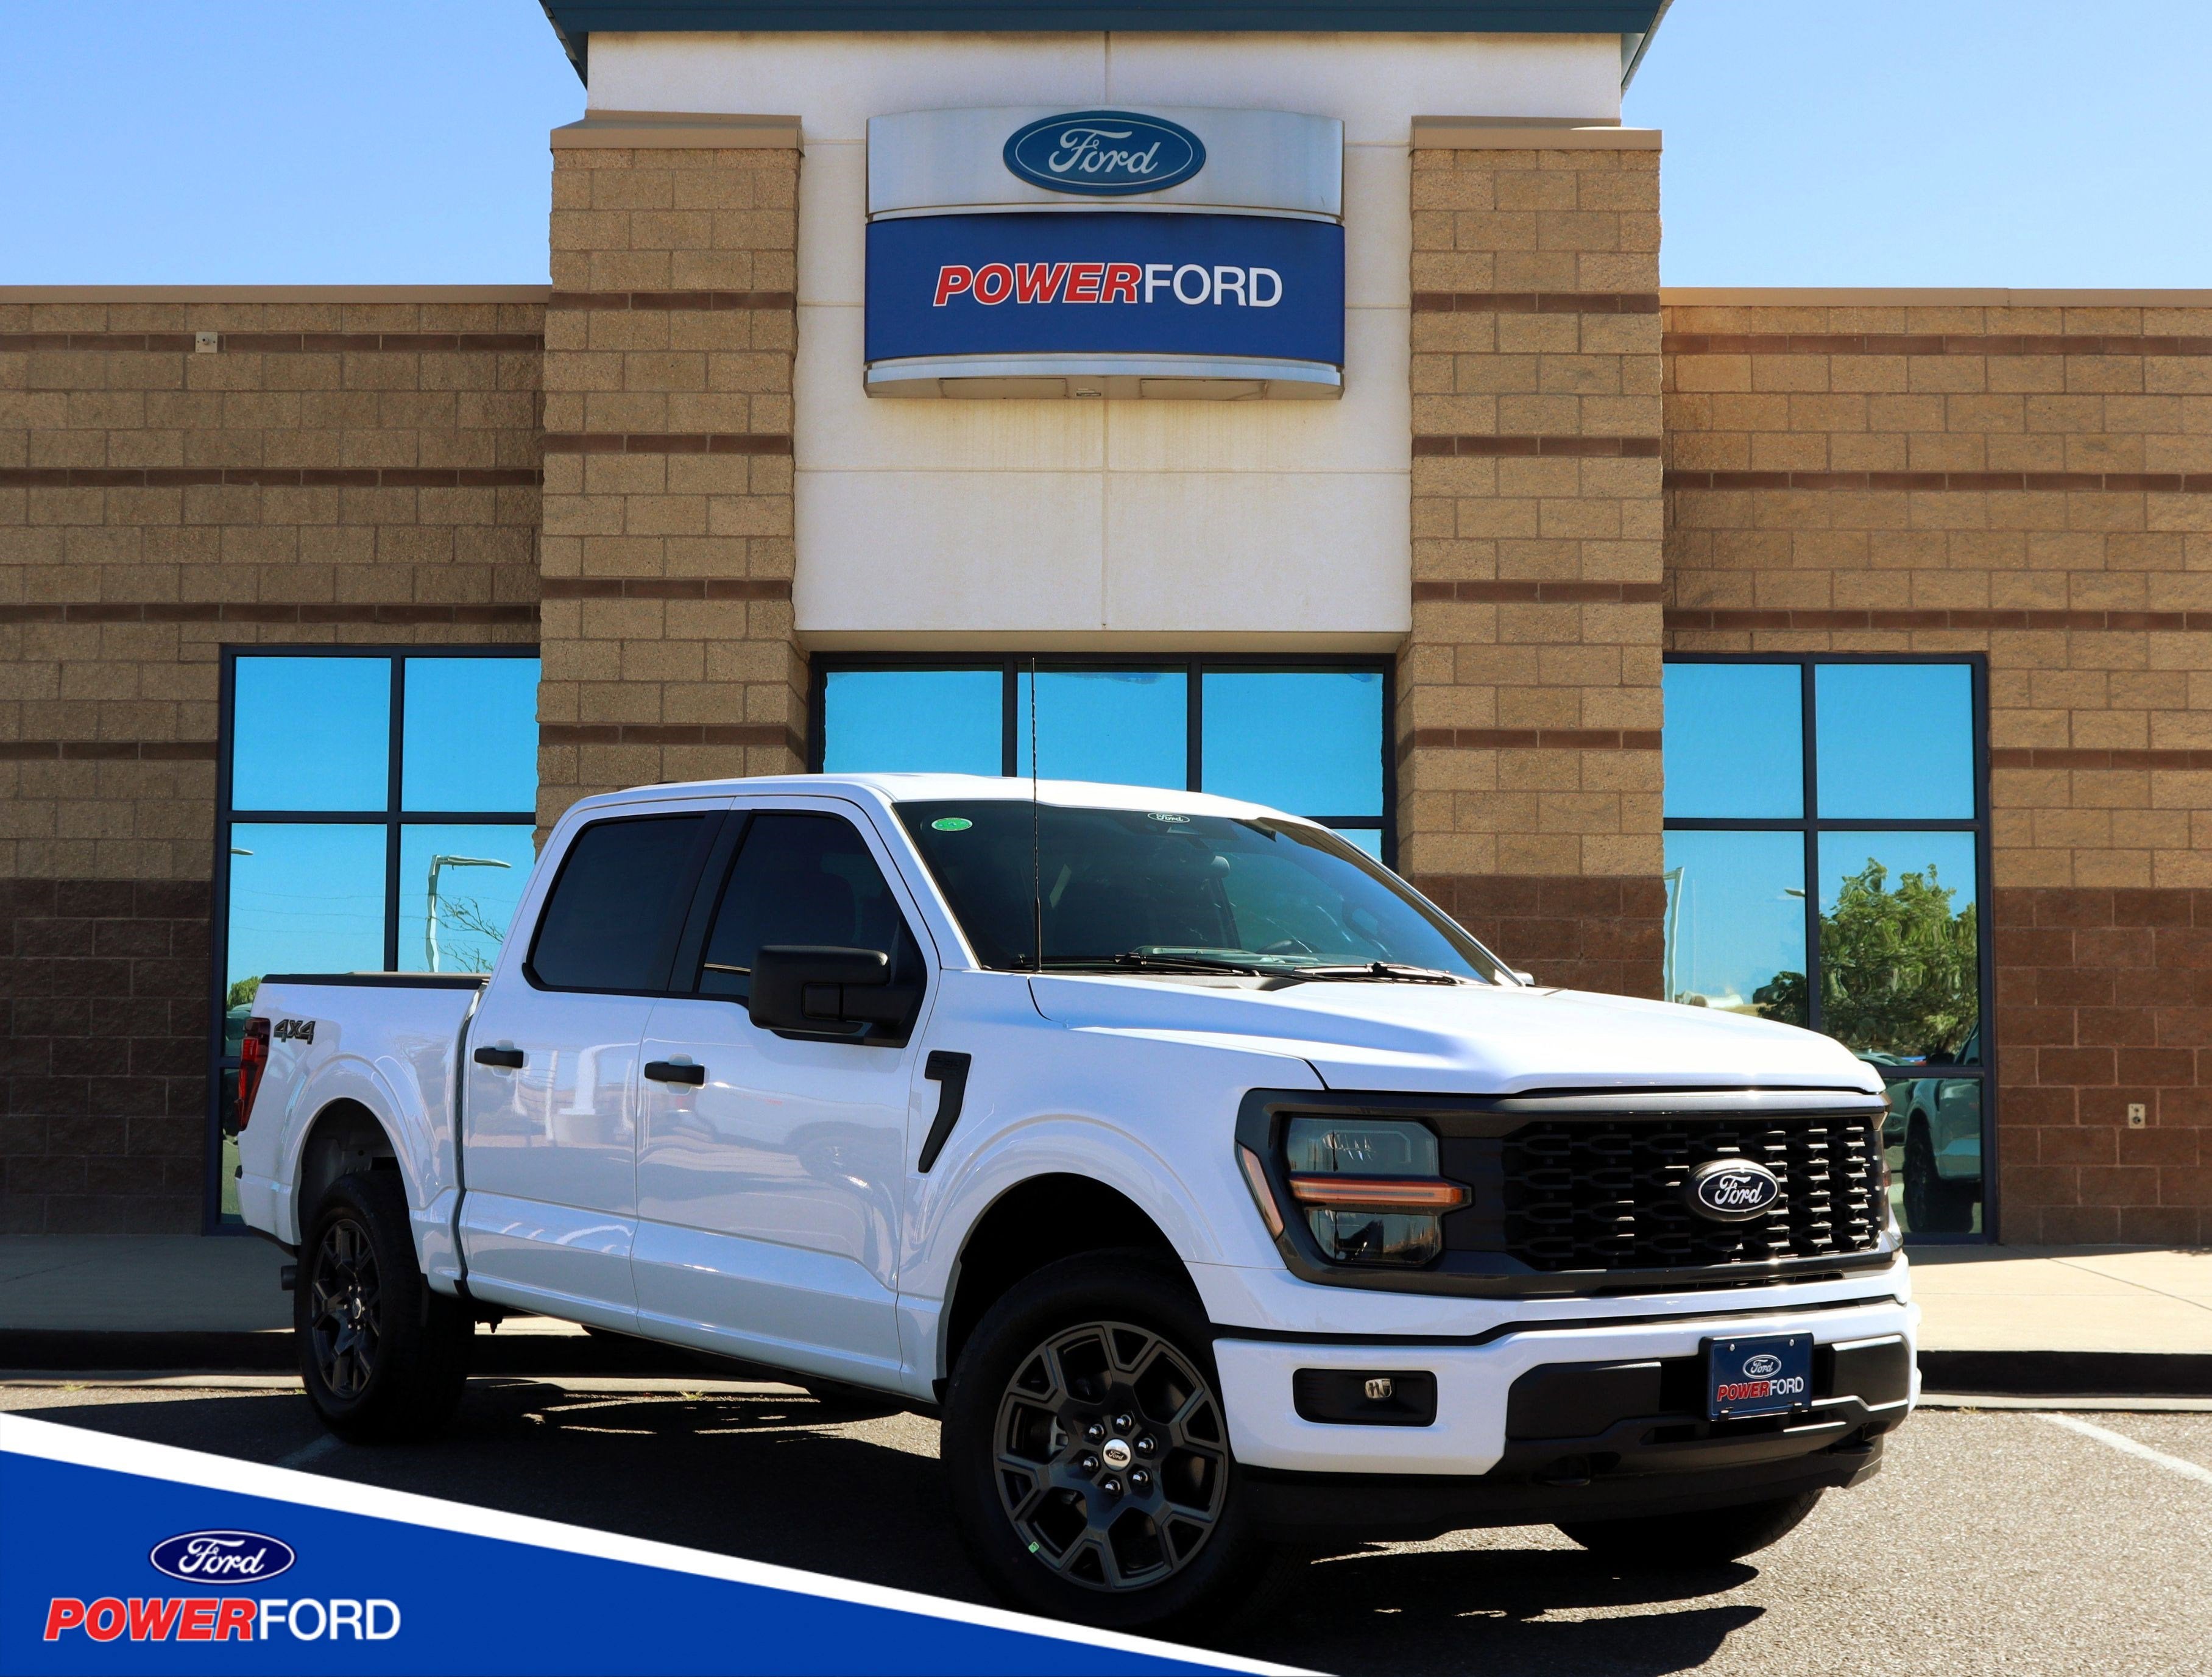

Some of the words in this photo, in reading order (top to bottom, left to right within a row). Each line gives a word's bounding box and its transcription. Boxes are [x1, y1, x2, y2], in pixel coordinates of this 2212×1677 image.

[1049, 127, 1161, 174] Ford
[1156, 813, 1184, 822] Ford
[1714, 1174, 1763, 1205] Ford
[1750, 1359, 1773, 1374] Ford
[1108, 1450, 1125, 1460] Ford
